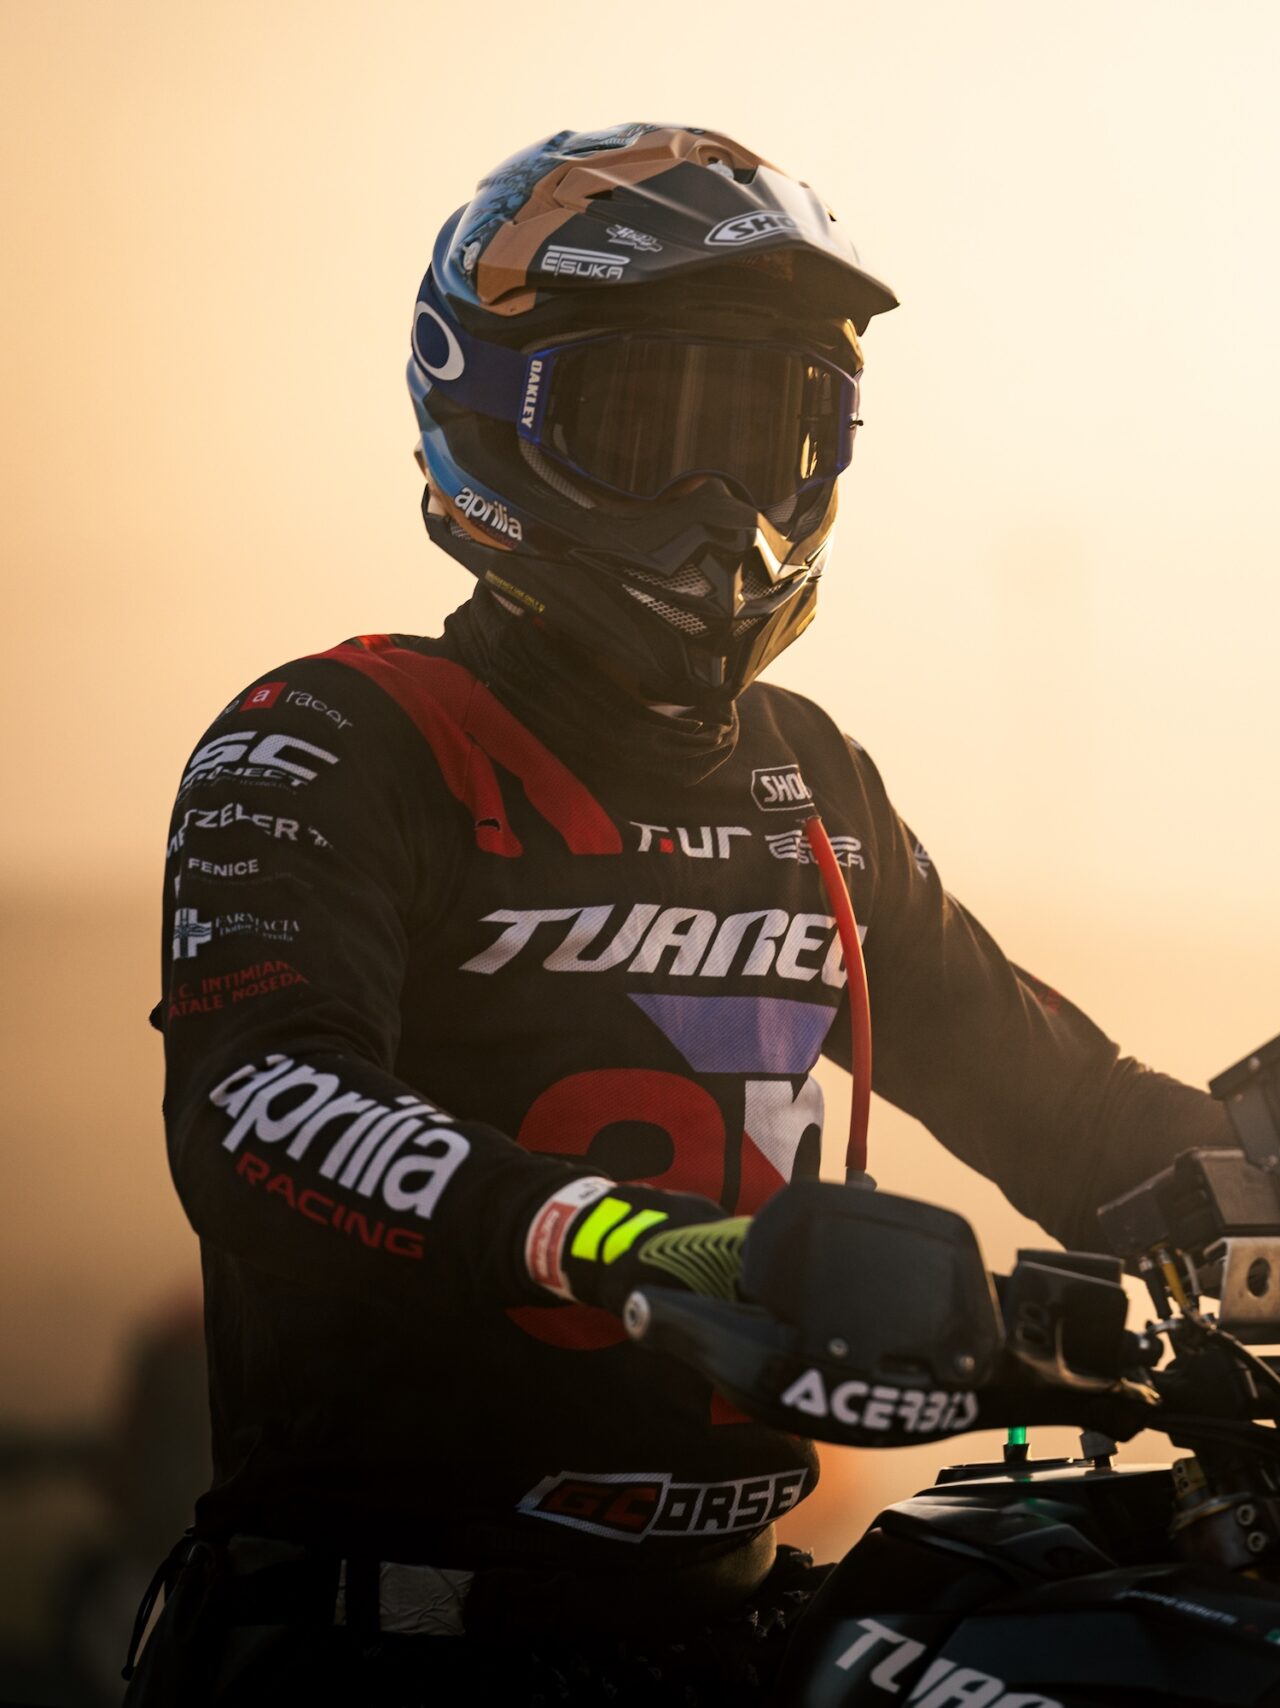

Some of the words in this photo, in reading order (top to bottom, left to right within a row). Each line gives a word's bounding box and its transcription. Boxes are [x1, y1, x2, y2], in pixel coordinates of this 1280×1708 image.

[521, 360, 543, 429] OAKLEY
[454, 487, 523, 541] aprilia
[252, 689, 273, 703] a
[285, 689, 353, 729] racer
[188, 857, 260, 877] FENICE
[209, 1054, 471, 1220] aprilia
[234, 1151, 425, 1260] RACING
